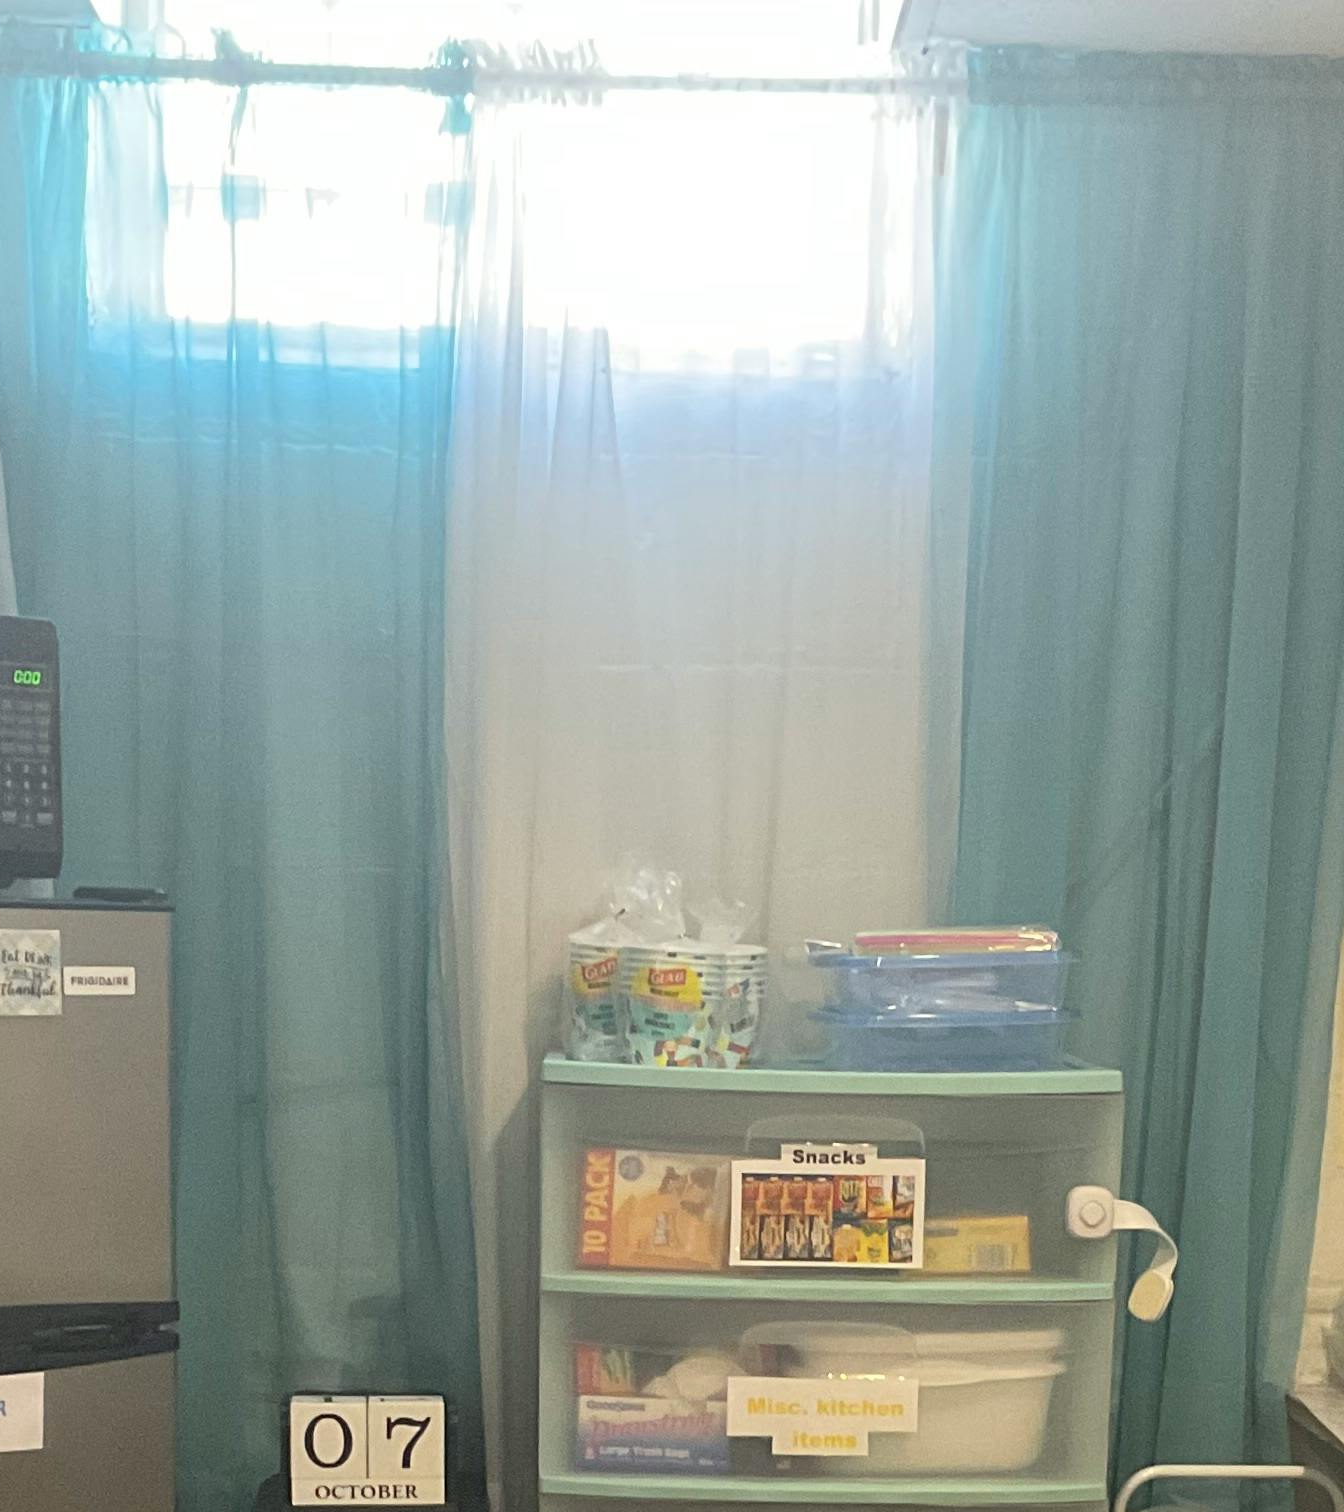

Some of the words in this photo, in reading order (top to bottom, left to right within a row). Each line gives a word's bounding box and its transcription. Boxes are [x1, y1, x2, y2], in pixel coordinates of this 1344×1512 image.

[70, 976, 129, 986] FRIGIDAIRE
[792, 1149, 866, 1165] Snacks
[583, 1151, 611, 1221] PACK
[582, 1230, 606, 1253] 10
[747, 1397, 808, 1416] Misc.
[816, 1399, 904, 1416] kitchen
[793, 1431, 859, 1449] items
[315, 1485, 418, 1499] OCTOBER
